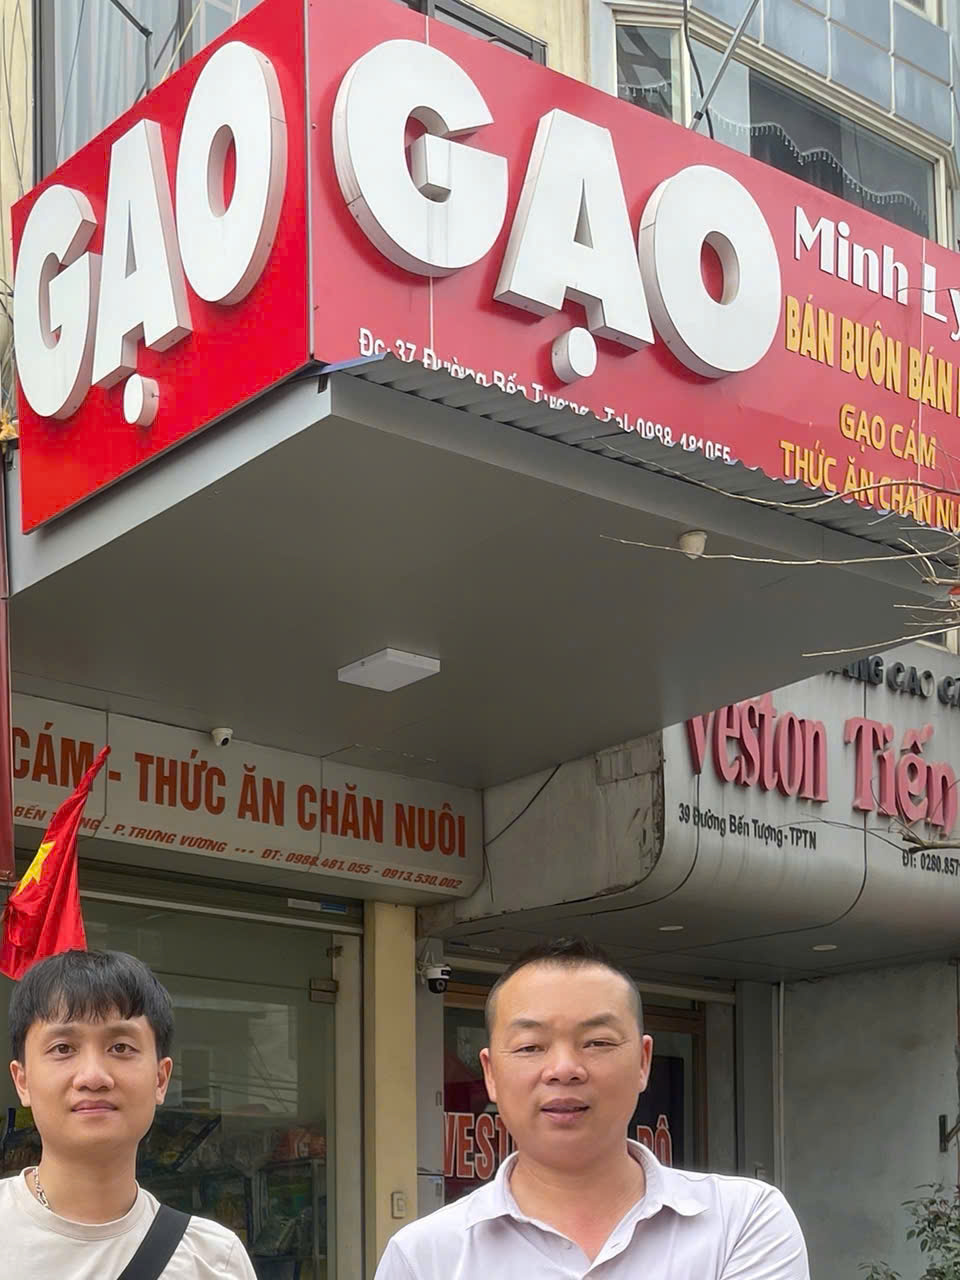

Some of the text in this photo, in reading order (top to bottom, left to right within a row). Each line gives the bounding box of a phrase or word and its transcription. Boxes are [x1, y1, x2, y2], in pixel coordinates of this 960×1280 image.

[14, 40, 288, 427] GẠO
[331, 38, 781, 385] GẠO
[794, 205, 909, 307] Minh
[785, 294, 835, 368] BÁN
[840, 316, 902, 394] BUÔN
[907, 346, 953, 414] BÁN
[779, 440, 837, 493] THỨC
[843, 456, 874, 505] ĂN
[839, 402, 937, 470] GẠO CÁM
[134, 749, 227, 816] THỨC
[237, 763, 285, 827] ĂN
[297, 782, 384, 844] CHĂN
[394, 802, 467, 859] NUÔI
[678, 802, 691, 825] 39
[692, 805, 727, 838] Đường
[729, 813, 750, 838] Bến
